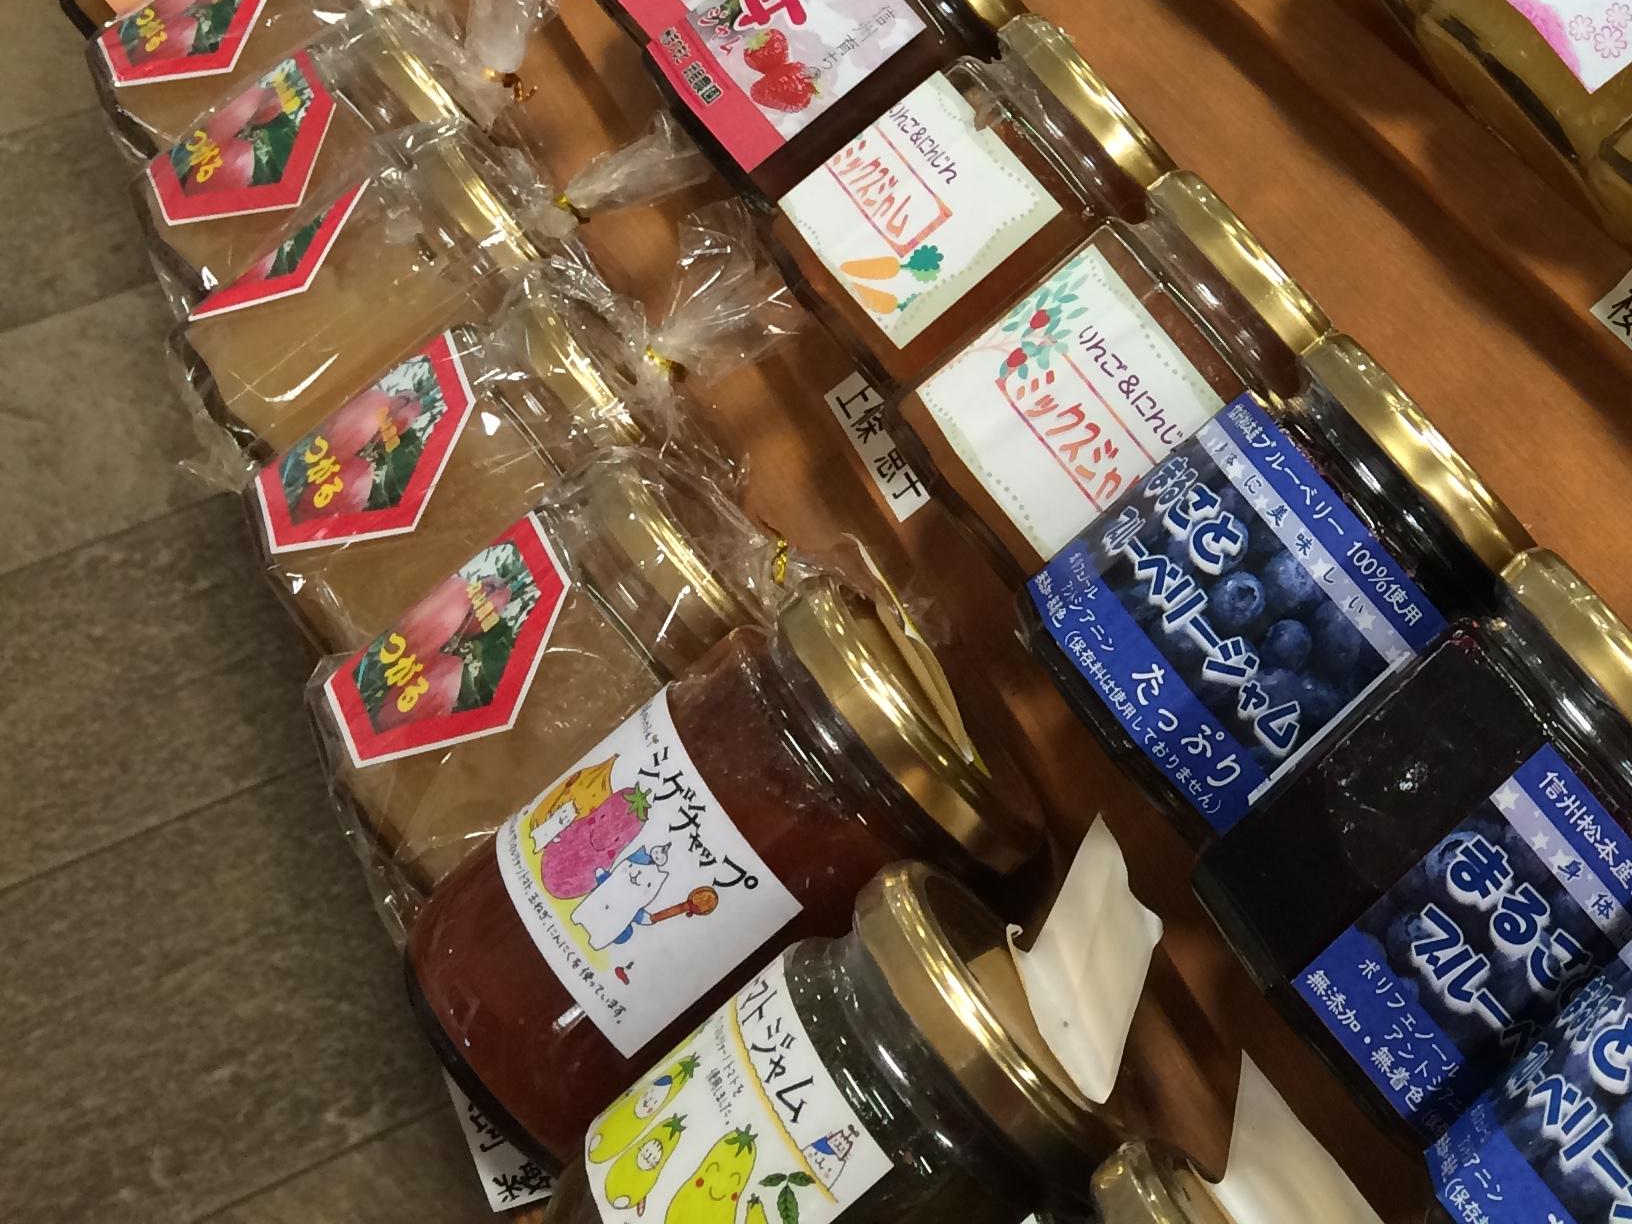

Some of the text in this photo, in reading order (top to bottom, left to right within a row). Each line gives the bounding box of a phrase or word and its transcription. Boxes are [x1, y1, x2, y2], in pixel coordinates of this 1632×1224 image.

[1345, 538, 1425, 628] 100%使用
[1130, 661, 1244, 789] たっぷり
[1305, 967, 1424, 1114] 無添加・無着色
[1356, 957, 1460, 1079] ポリフェノール
